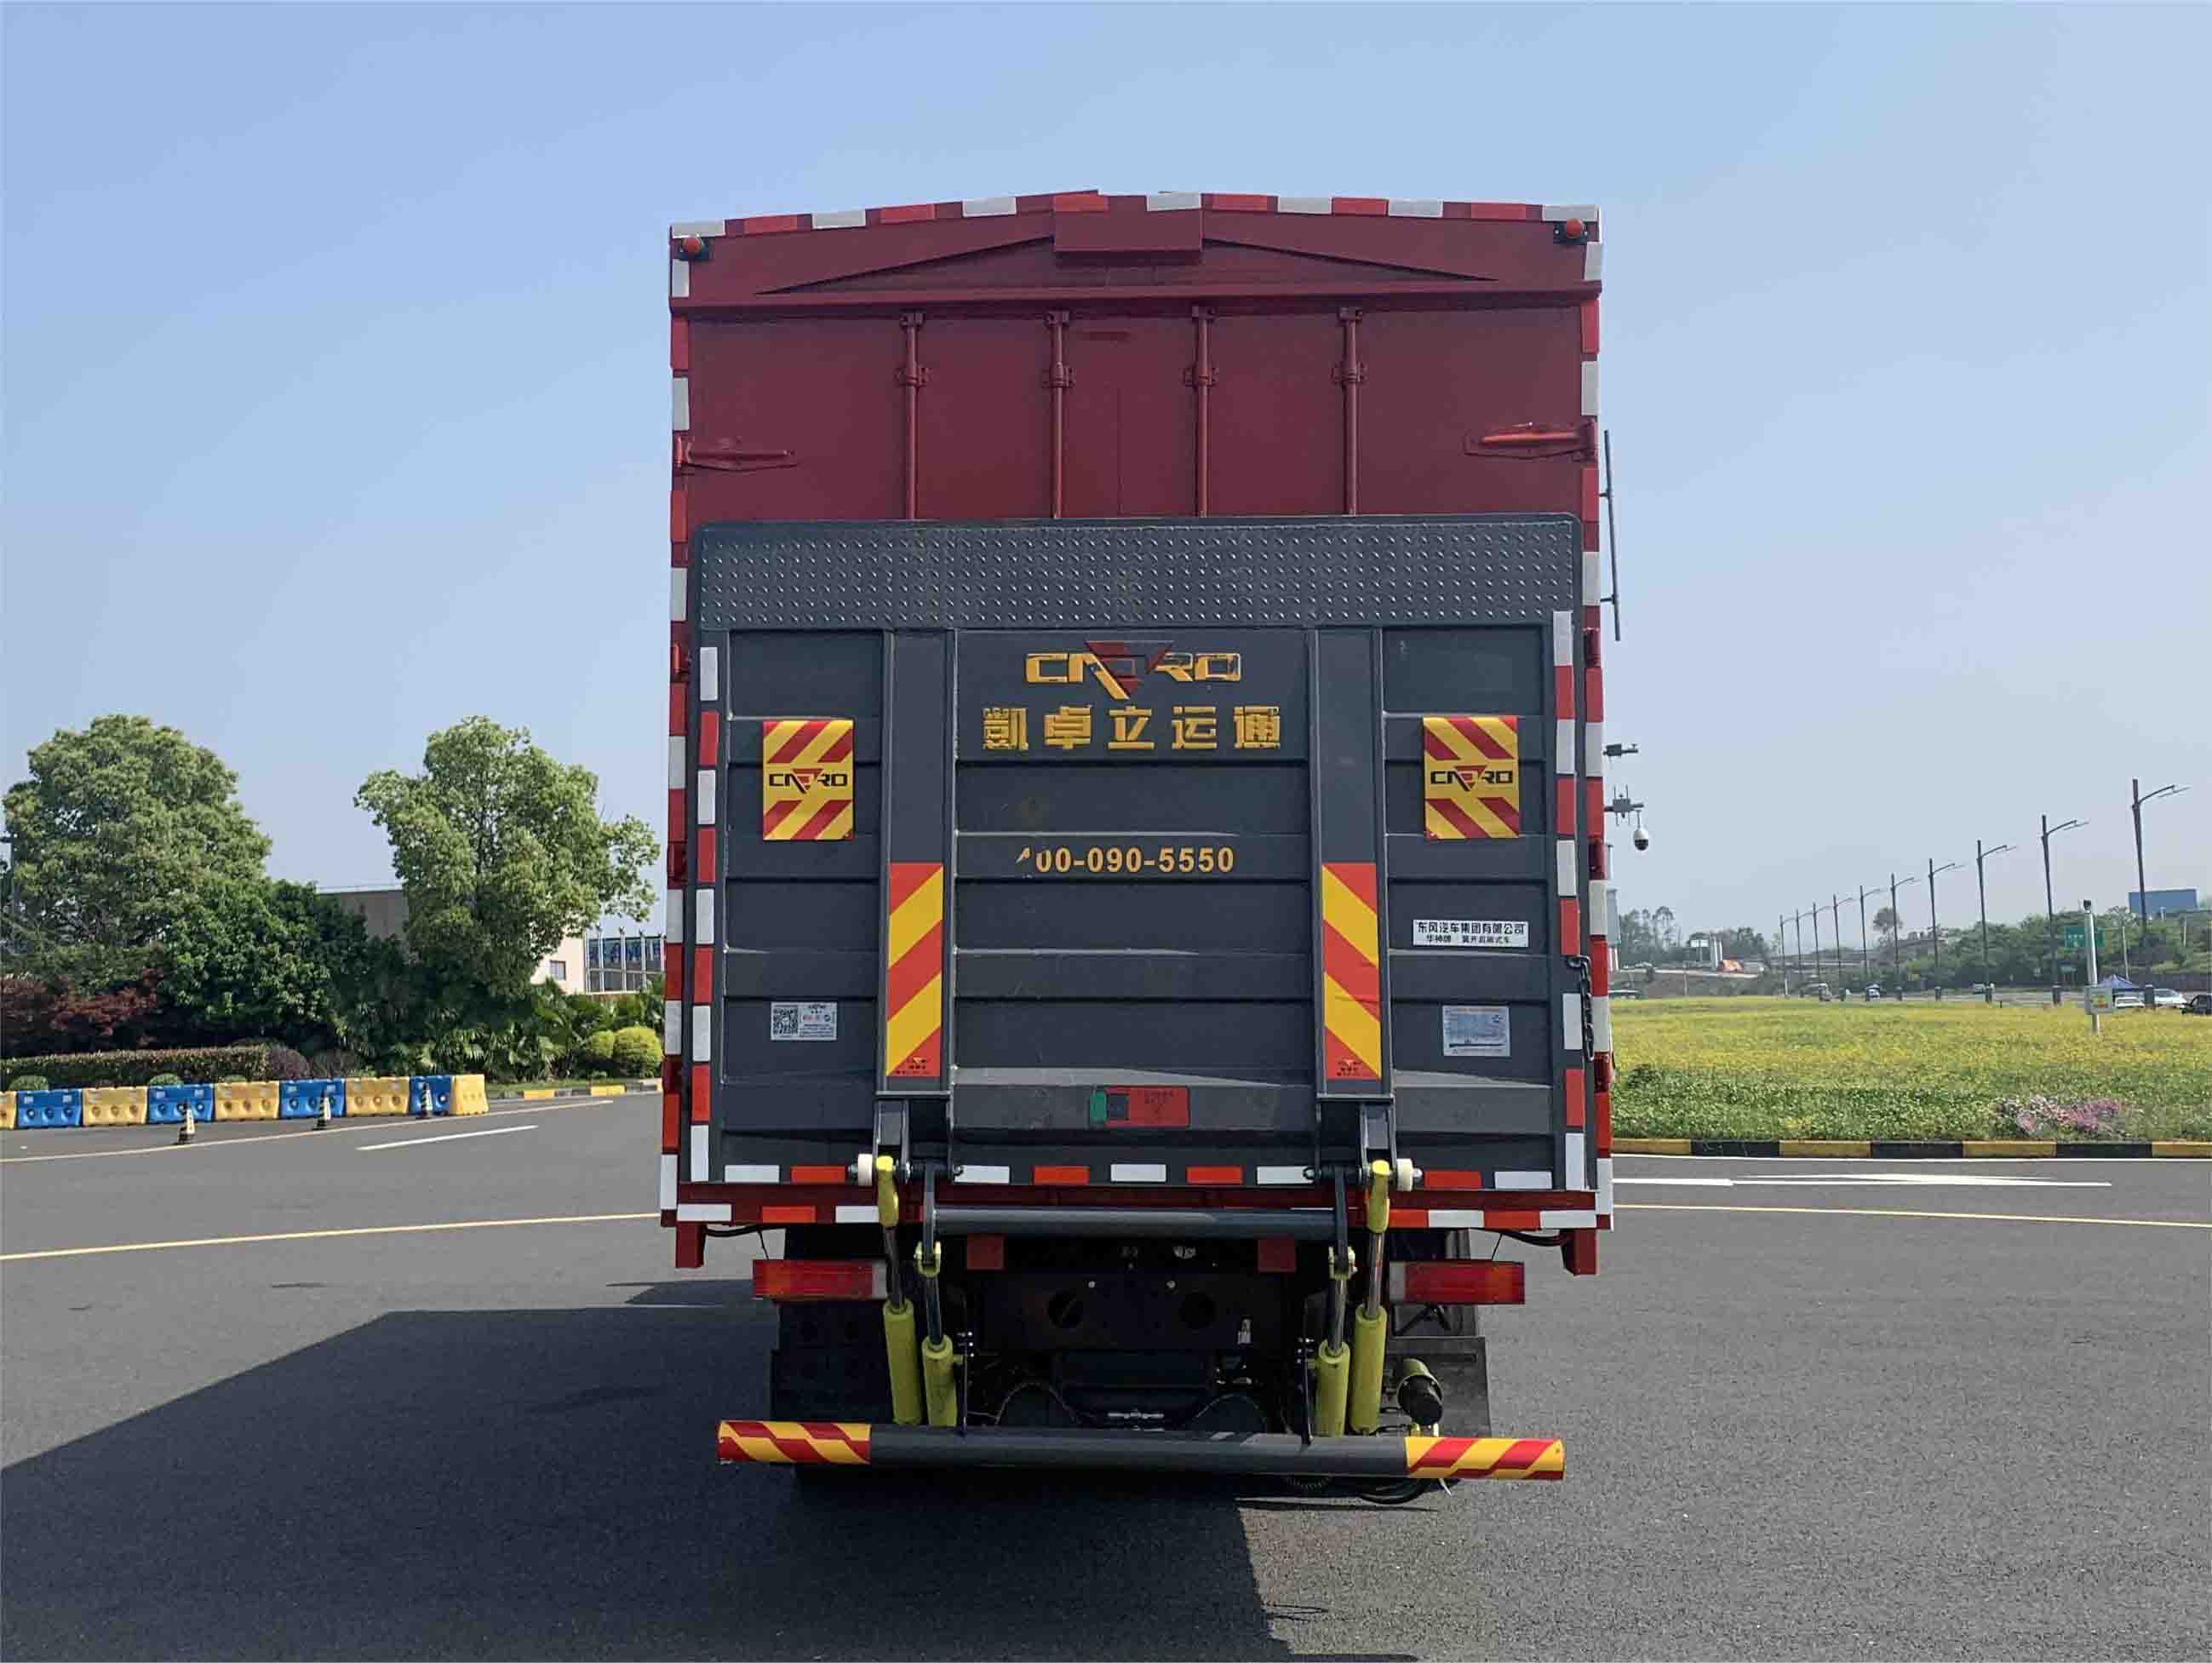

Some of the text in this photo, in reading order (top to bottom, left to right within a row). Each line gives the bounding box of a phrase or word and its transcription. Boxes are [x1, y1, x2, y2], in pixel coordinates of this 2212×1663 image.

[983, 706, 1281, 750] 凯卓立运通
[1417, 921, 1526, 934] 东风汽车集团有限公司
